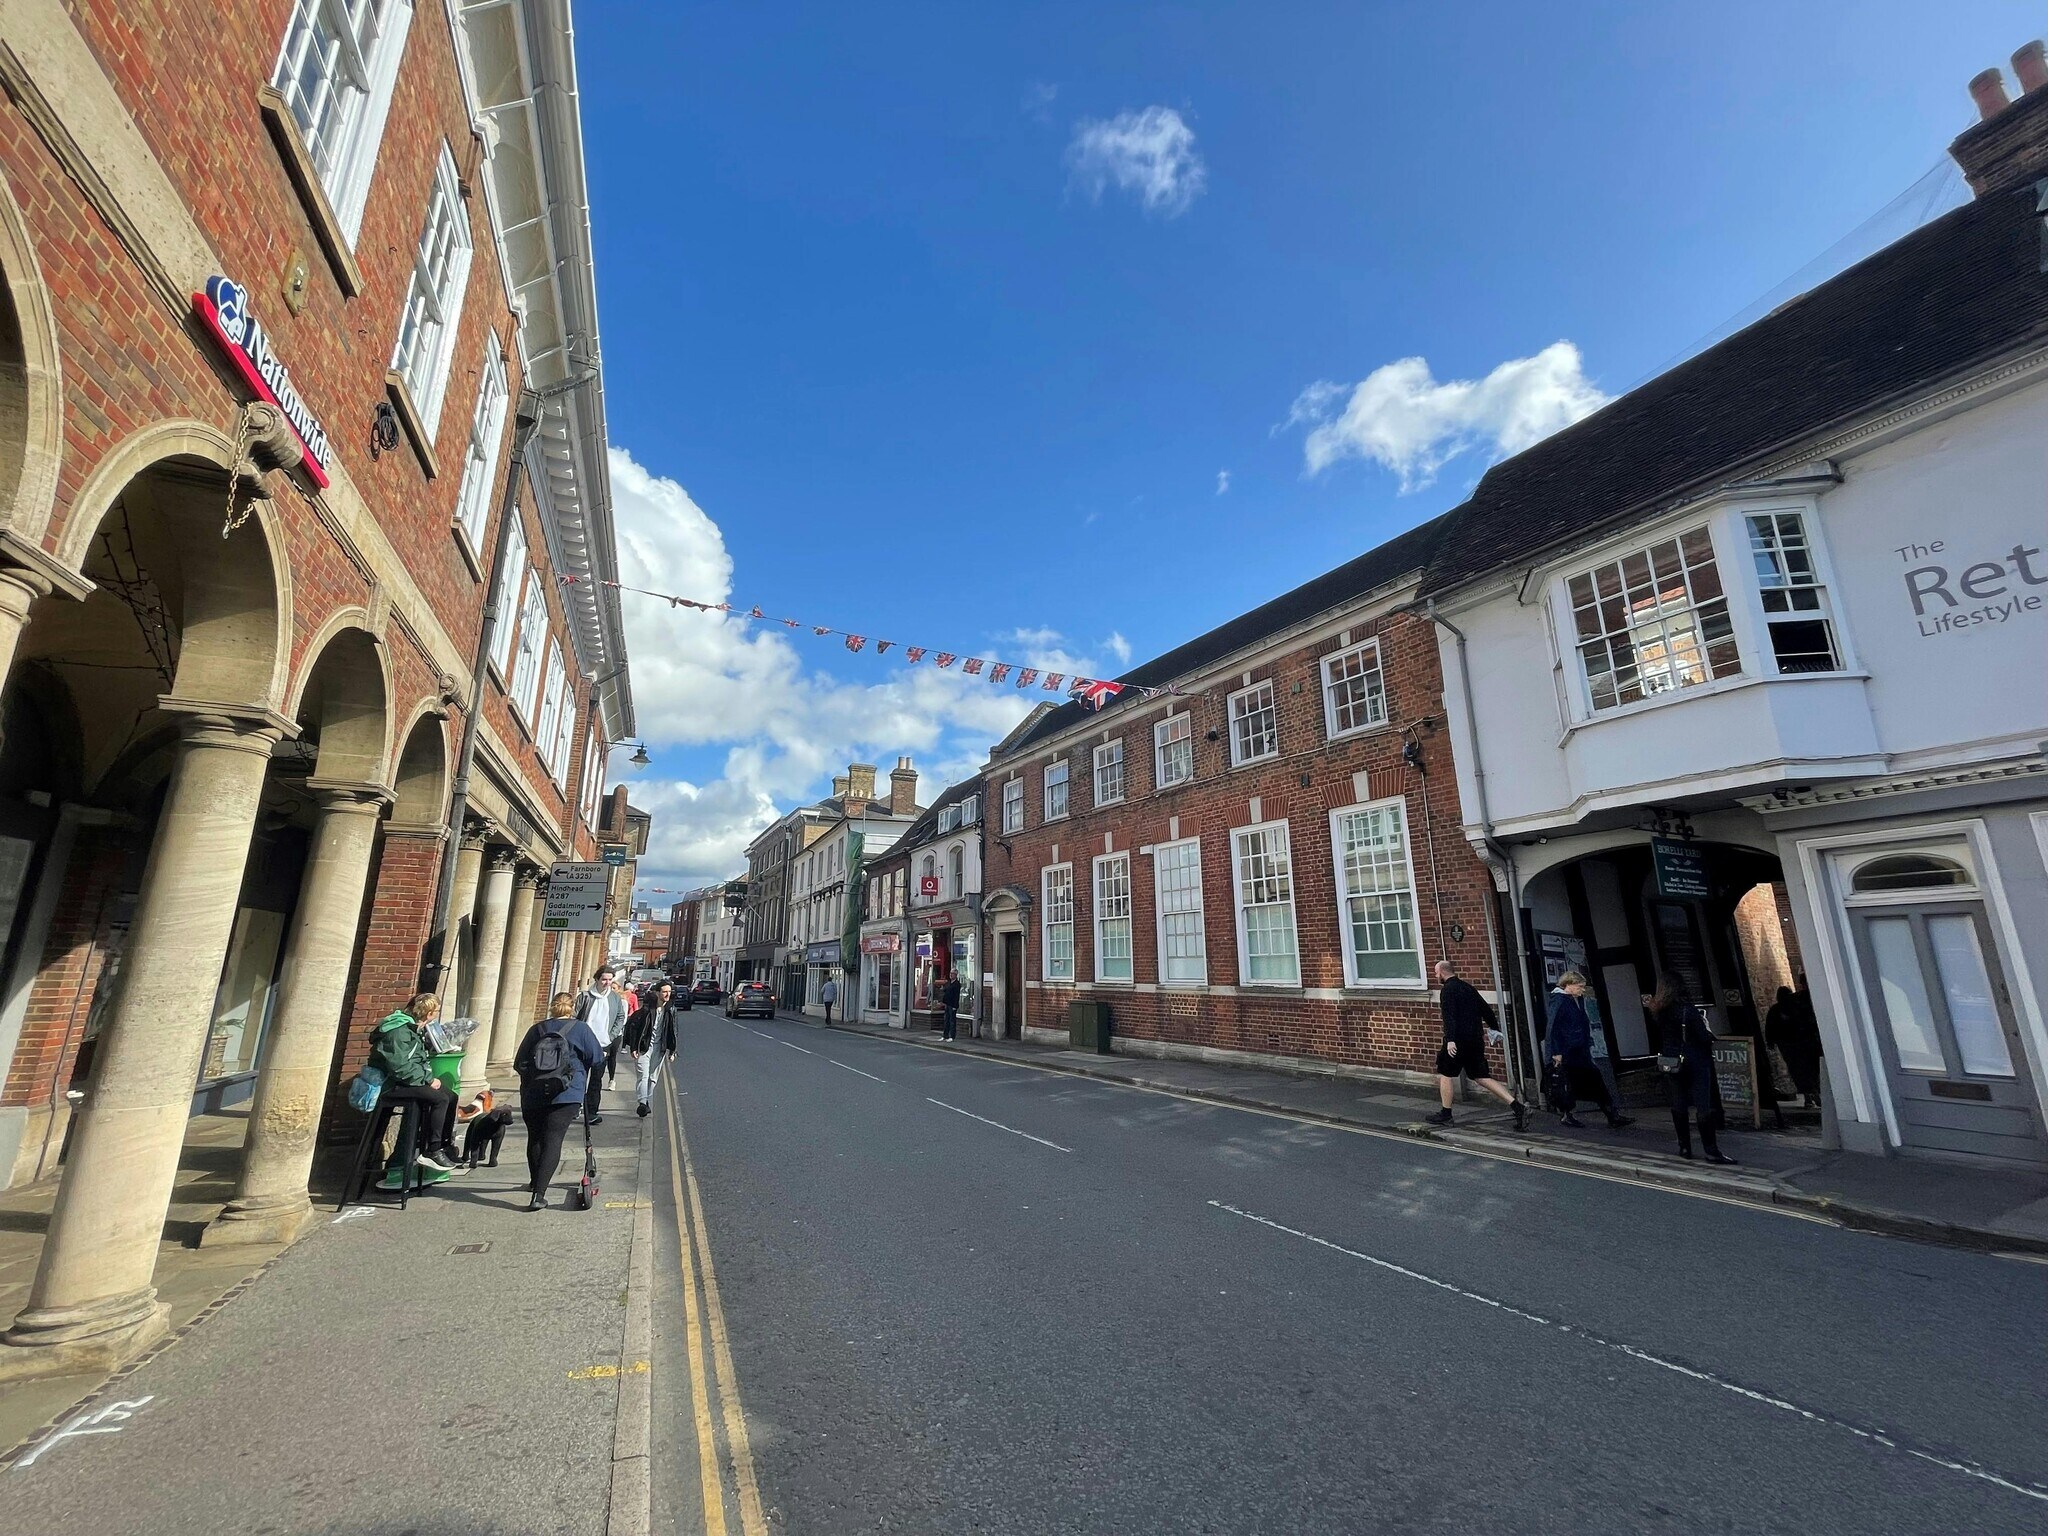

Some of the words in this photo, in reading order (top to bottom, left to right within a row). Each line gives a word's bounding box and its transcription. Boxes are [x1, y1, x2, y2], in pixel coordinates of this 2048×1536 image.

[245, 318, 331, 471] Nationwide
[1895, 540, 1945, 562] The
[1918, 595, 2043, 637] Lifestyle
[548, 902, 585, 910] Godalming
